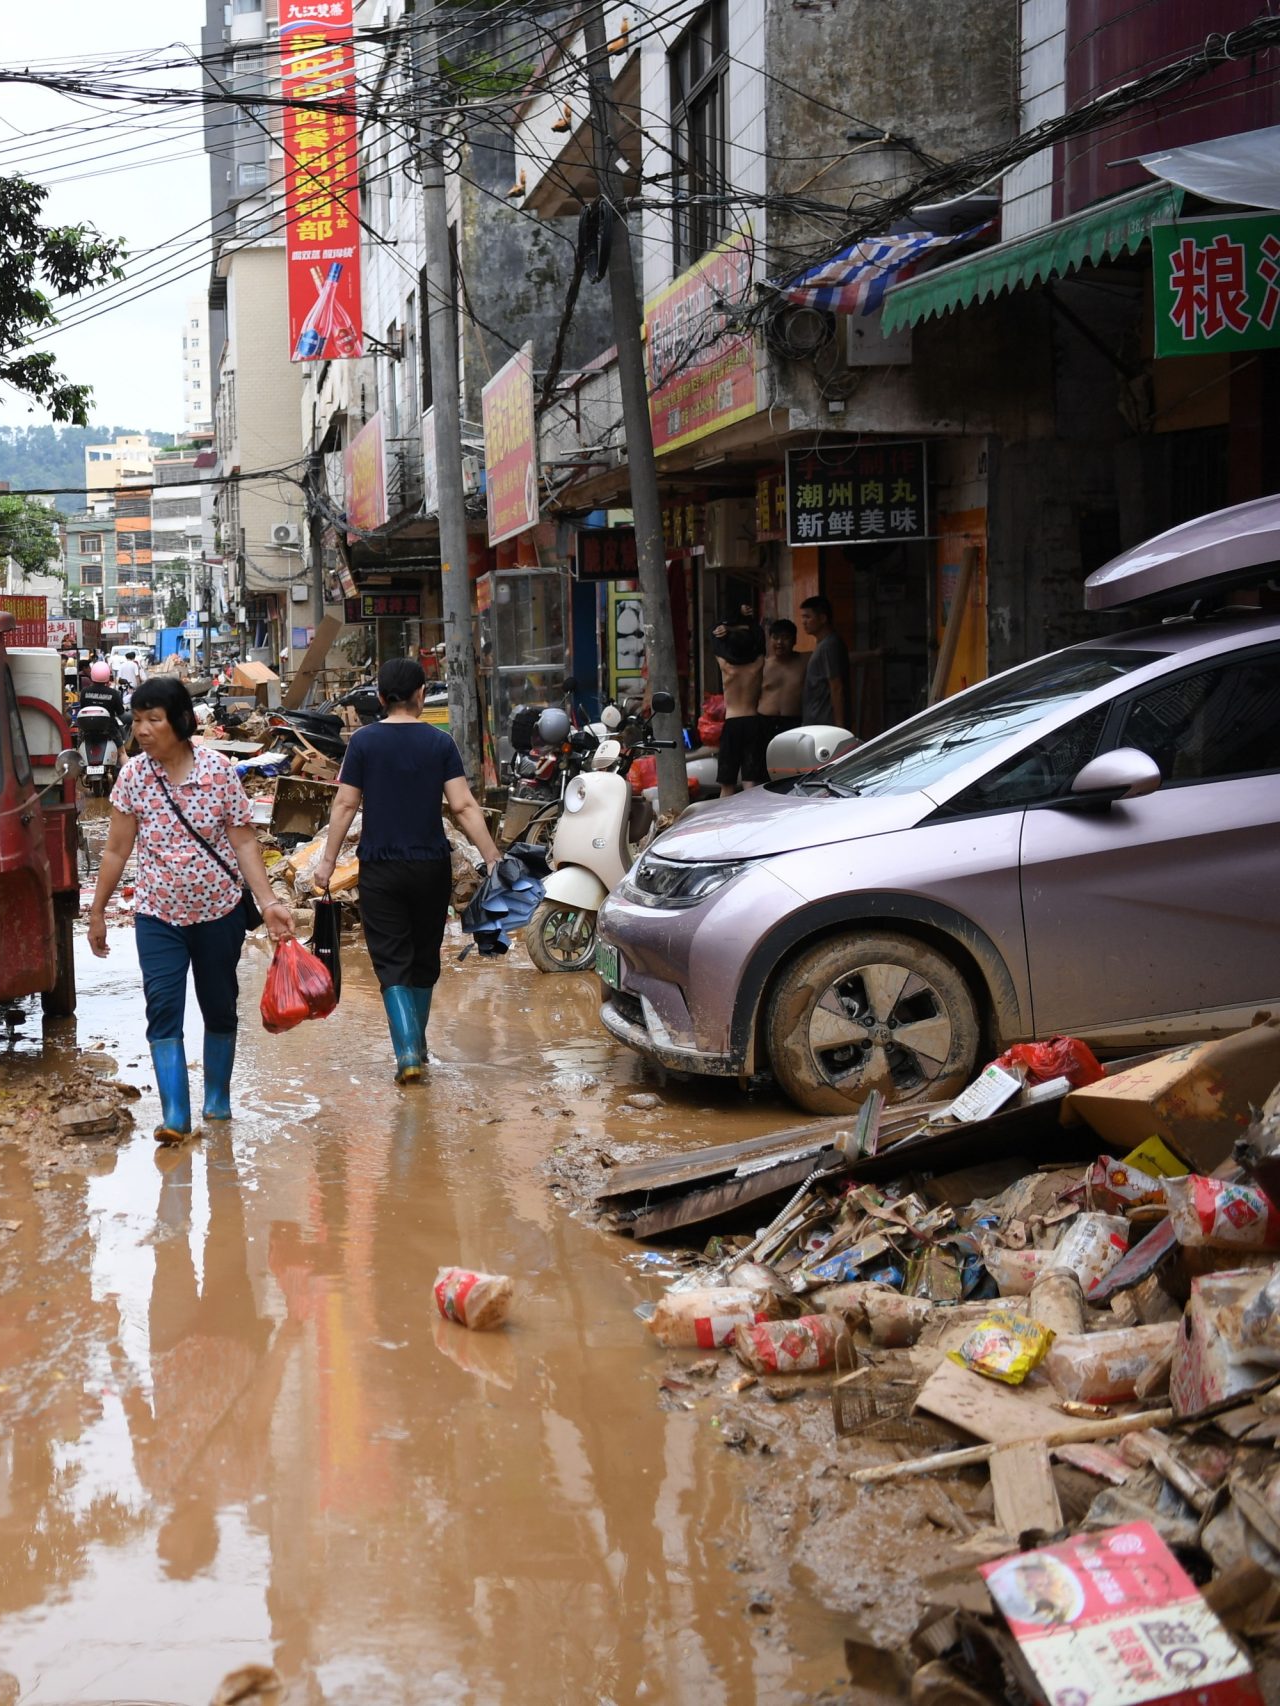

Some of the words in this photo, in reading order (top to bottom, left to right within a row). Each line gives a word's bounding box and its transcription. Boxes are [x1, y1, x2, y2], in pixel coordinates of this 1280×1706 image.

[796, 478, 918, 508] 潮州肉丸
[797, 508, 918, 538] 新鲜美味
